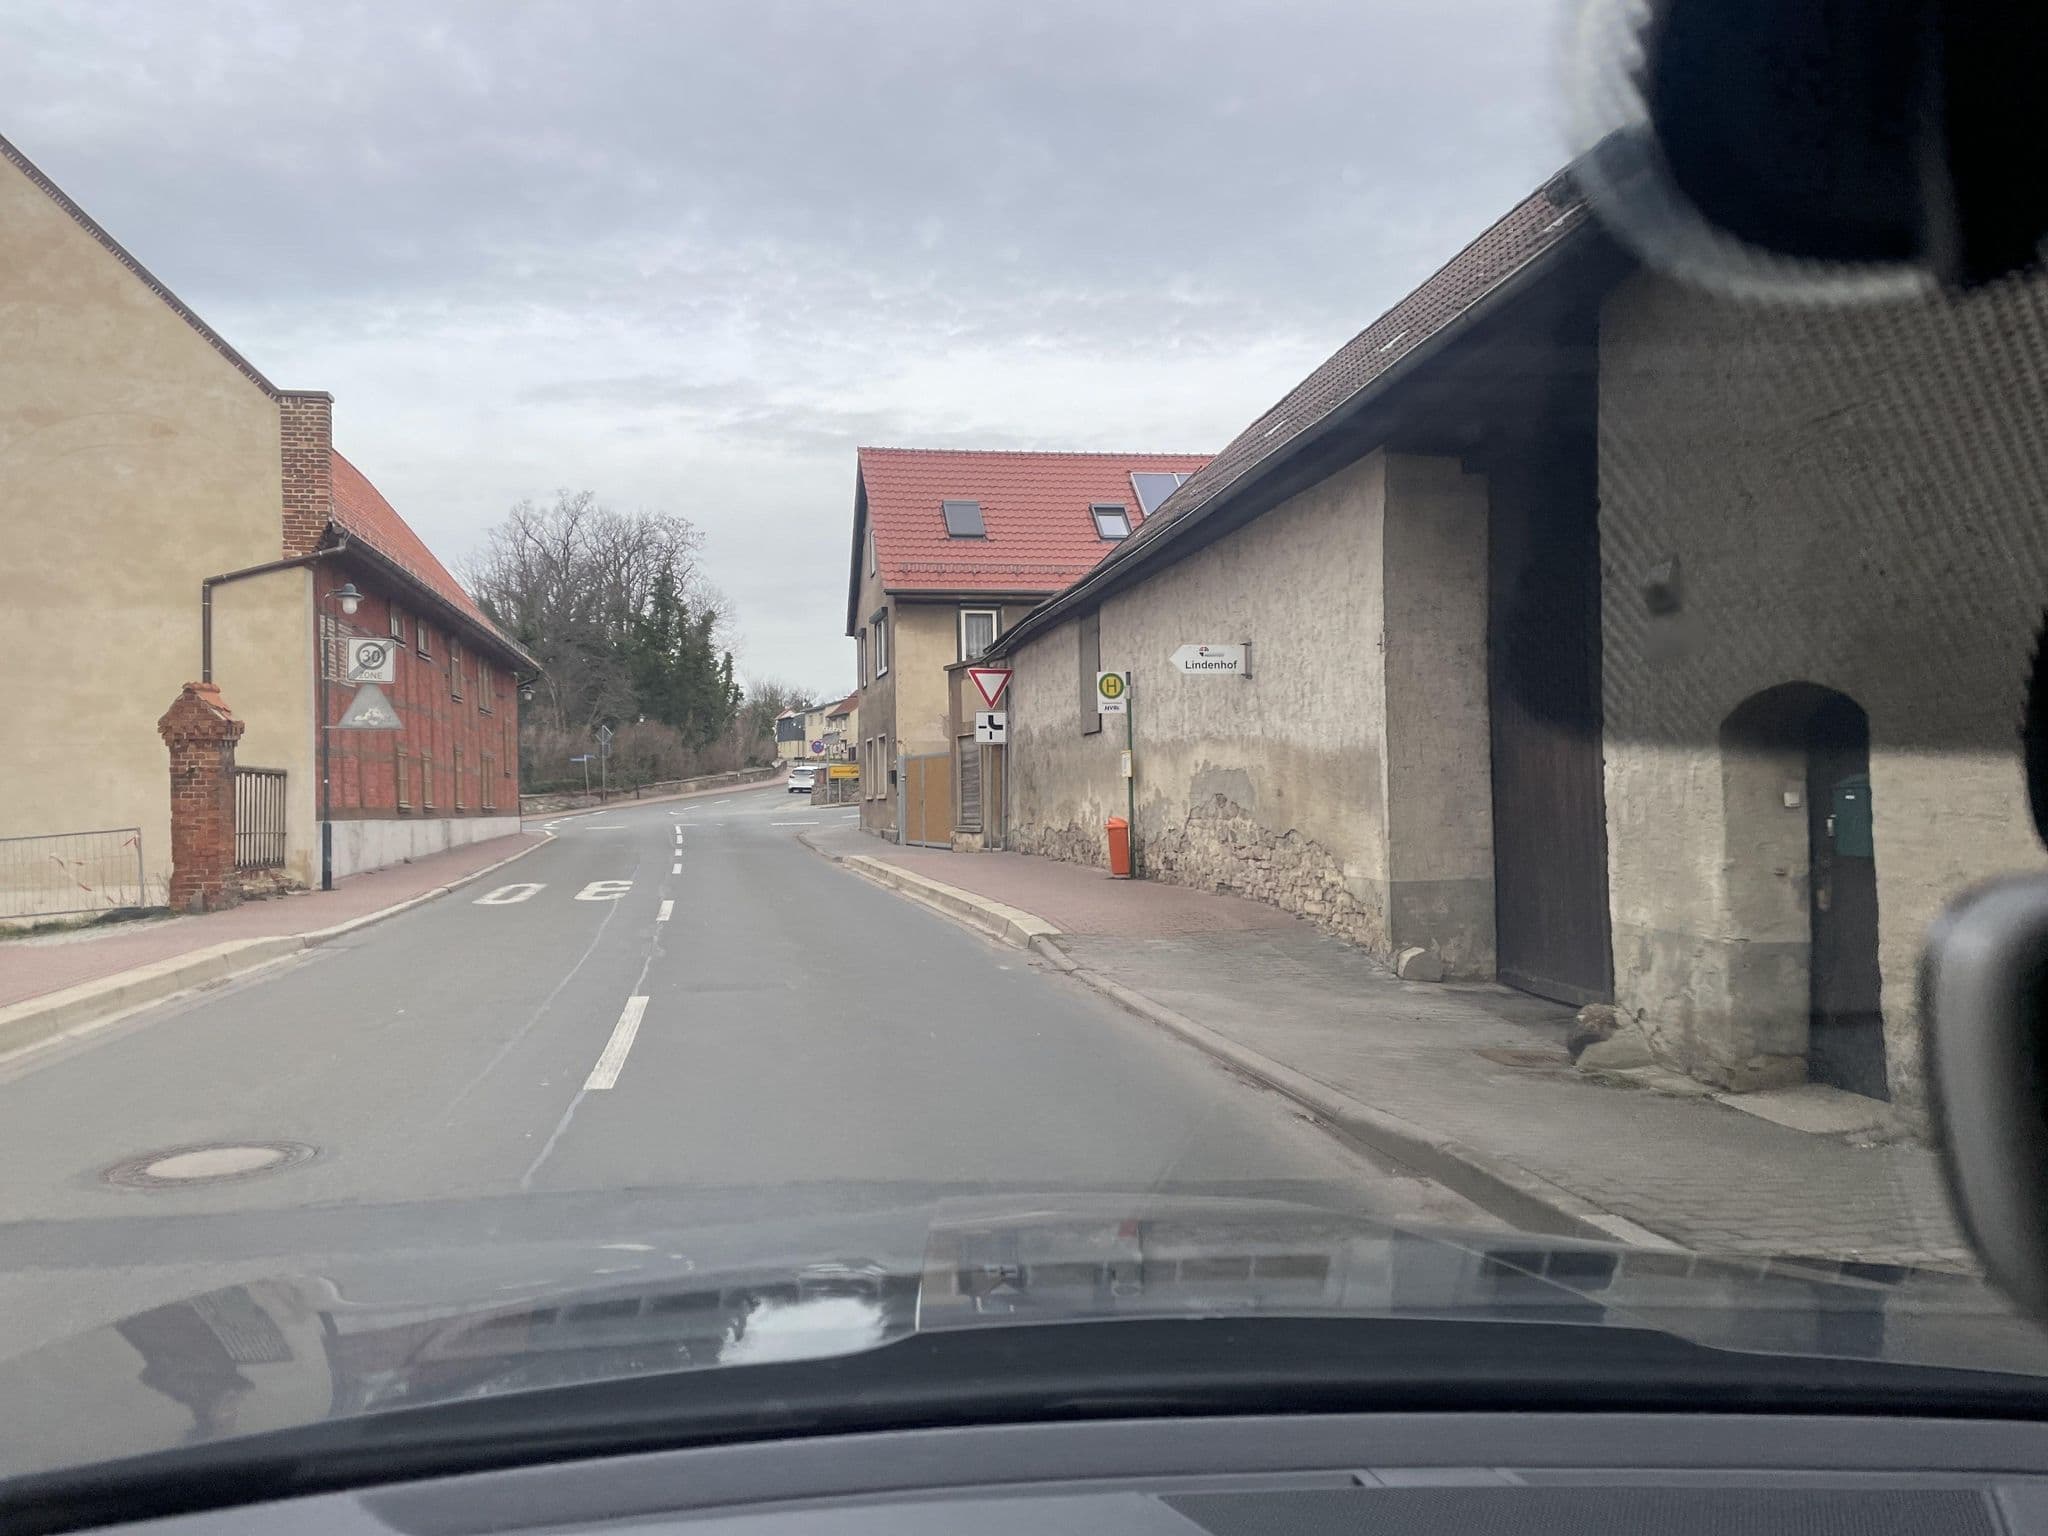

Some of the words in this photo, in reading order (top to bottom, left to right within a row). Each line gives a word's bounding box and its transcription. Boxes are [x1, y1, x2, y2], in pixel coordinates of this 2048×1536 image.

[362, 649, 381, 663] 30
[1185, 660, 1237, 669] Lindenhof
[1106, 678, 1117, 693] H
